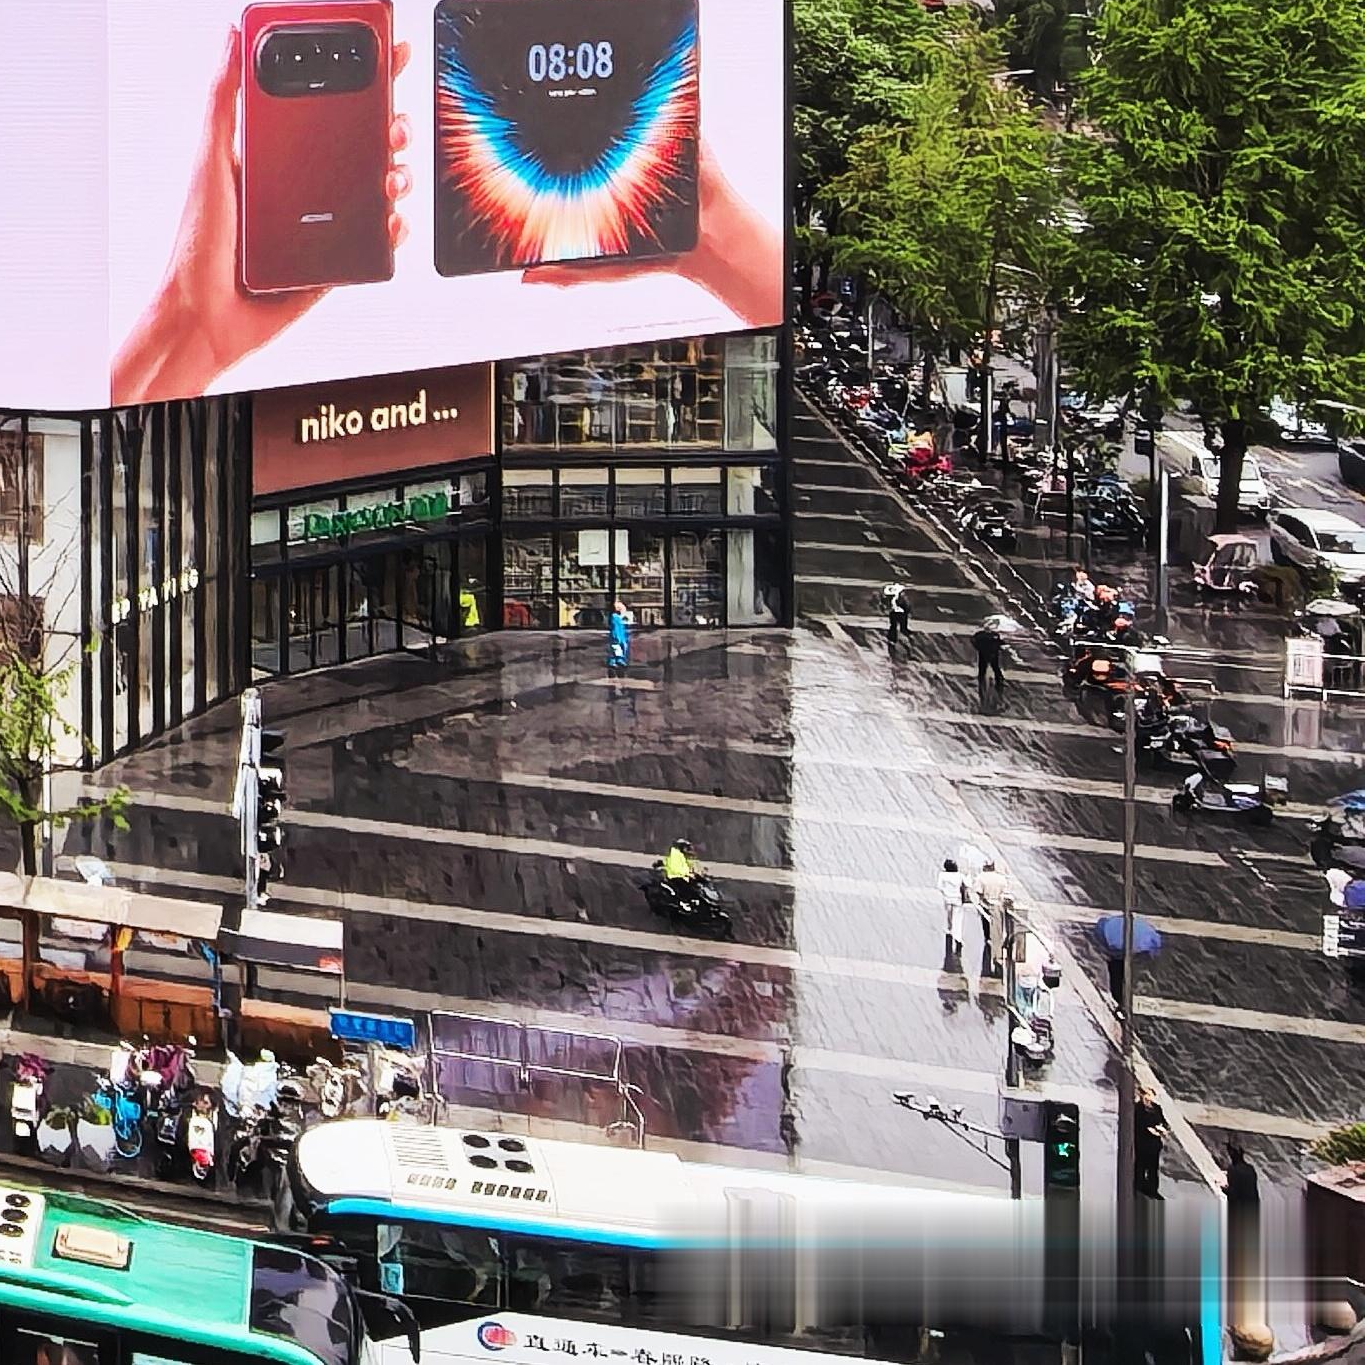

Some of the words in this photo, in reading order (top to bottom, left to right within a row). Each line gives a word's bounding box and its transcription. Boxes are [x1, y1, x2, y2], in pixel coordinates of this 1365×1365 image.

[528, 41, 613, 82] 08:08
[301, 403, 363, 443] niko
[371, 389, 426, 431] and
